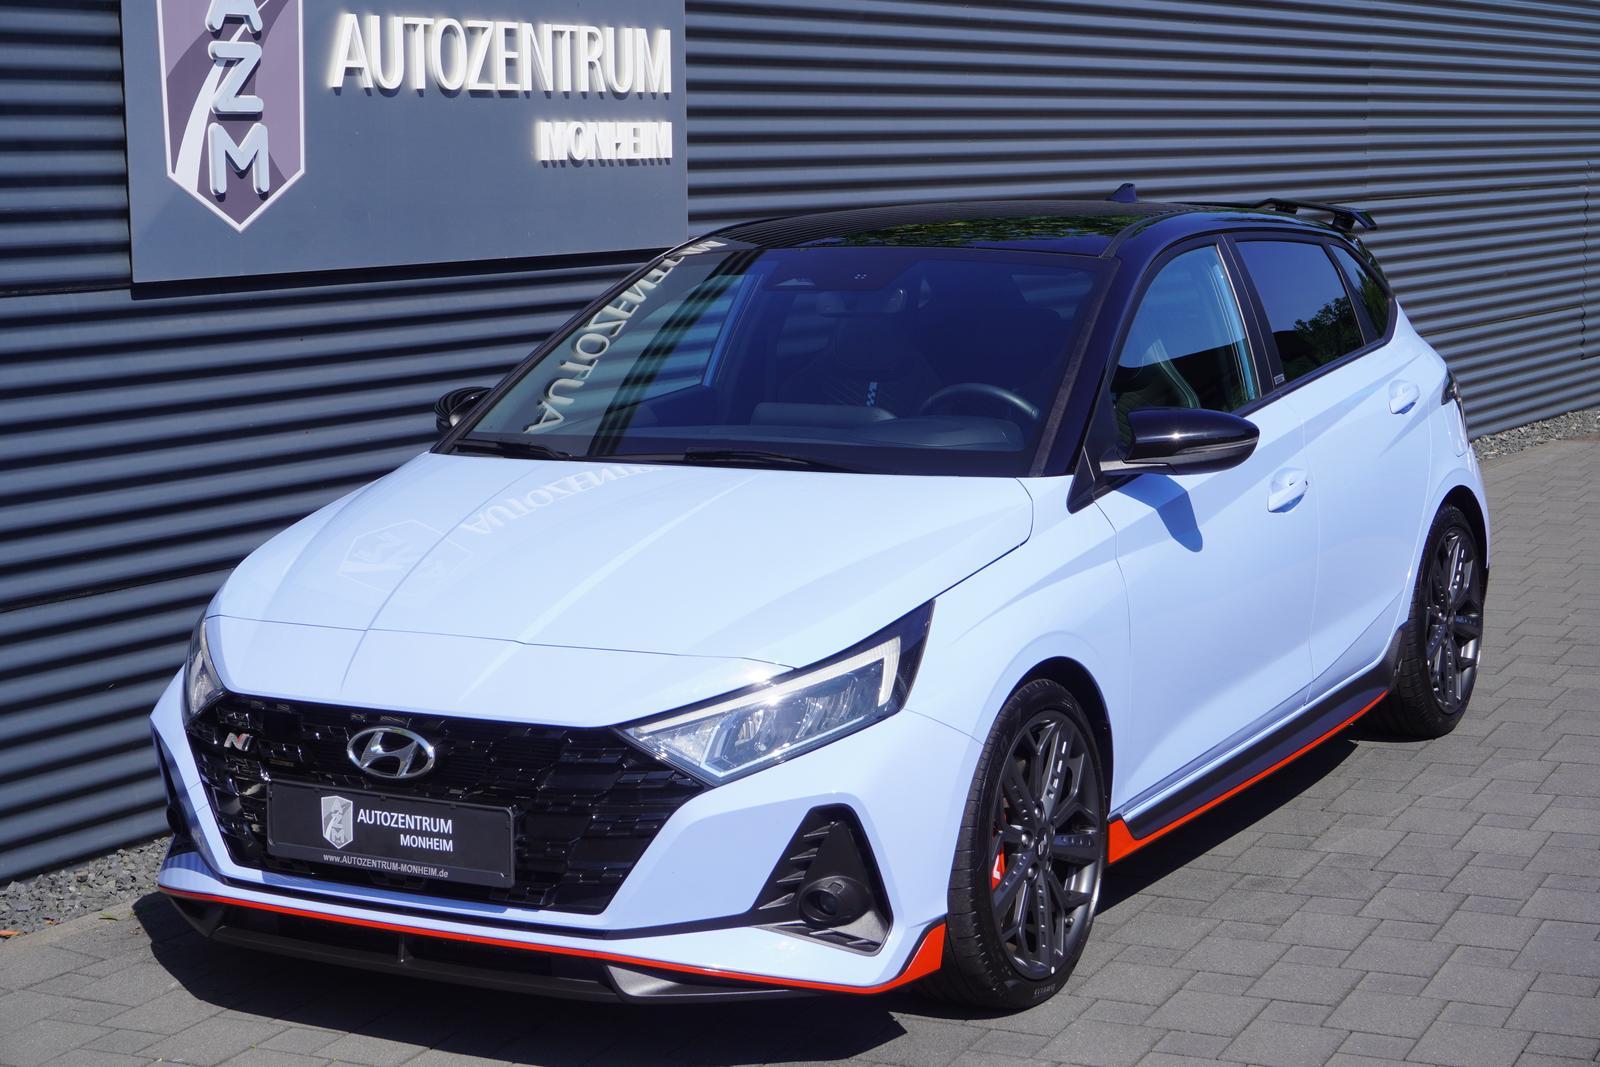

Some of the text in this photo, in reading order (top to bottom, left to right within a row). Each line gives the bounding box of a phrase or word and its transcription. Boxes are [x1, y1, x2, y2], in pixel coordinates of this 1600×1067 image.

[329, 13, 672, 94] AUTOZENTRUM
[535, 119, 673, 163] MONHEIM
[357, 808, 453, 835] AUTOZENTRUM
[400, 834, 453, 852] MONHEIM
[323, 853, 449, 878] www.AUTOZENTRUM-MONHEIM.de
